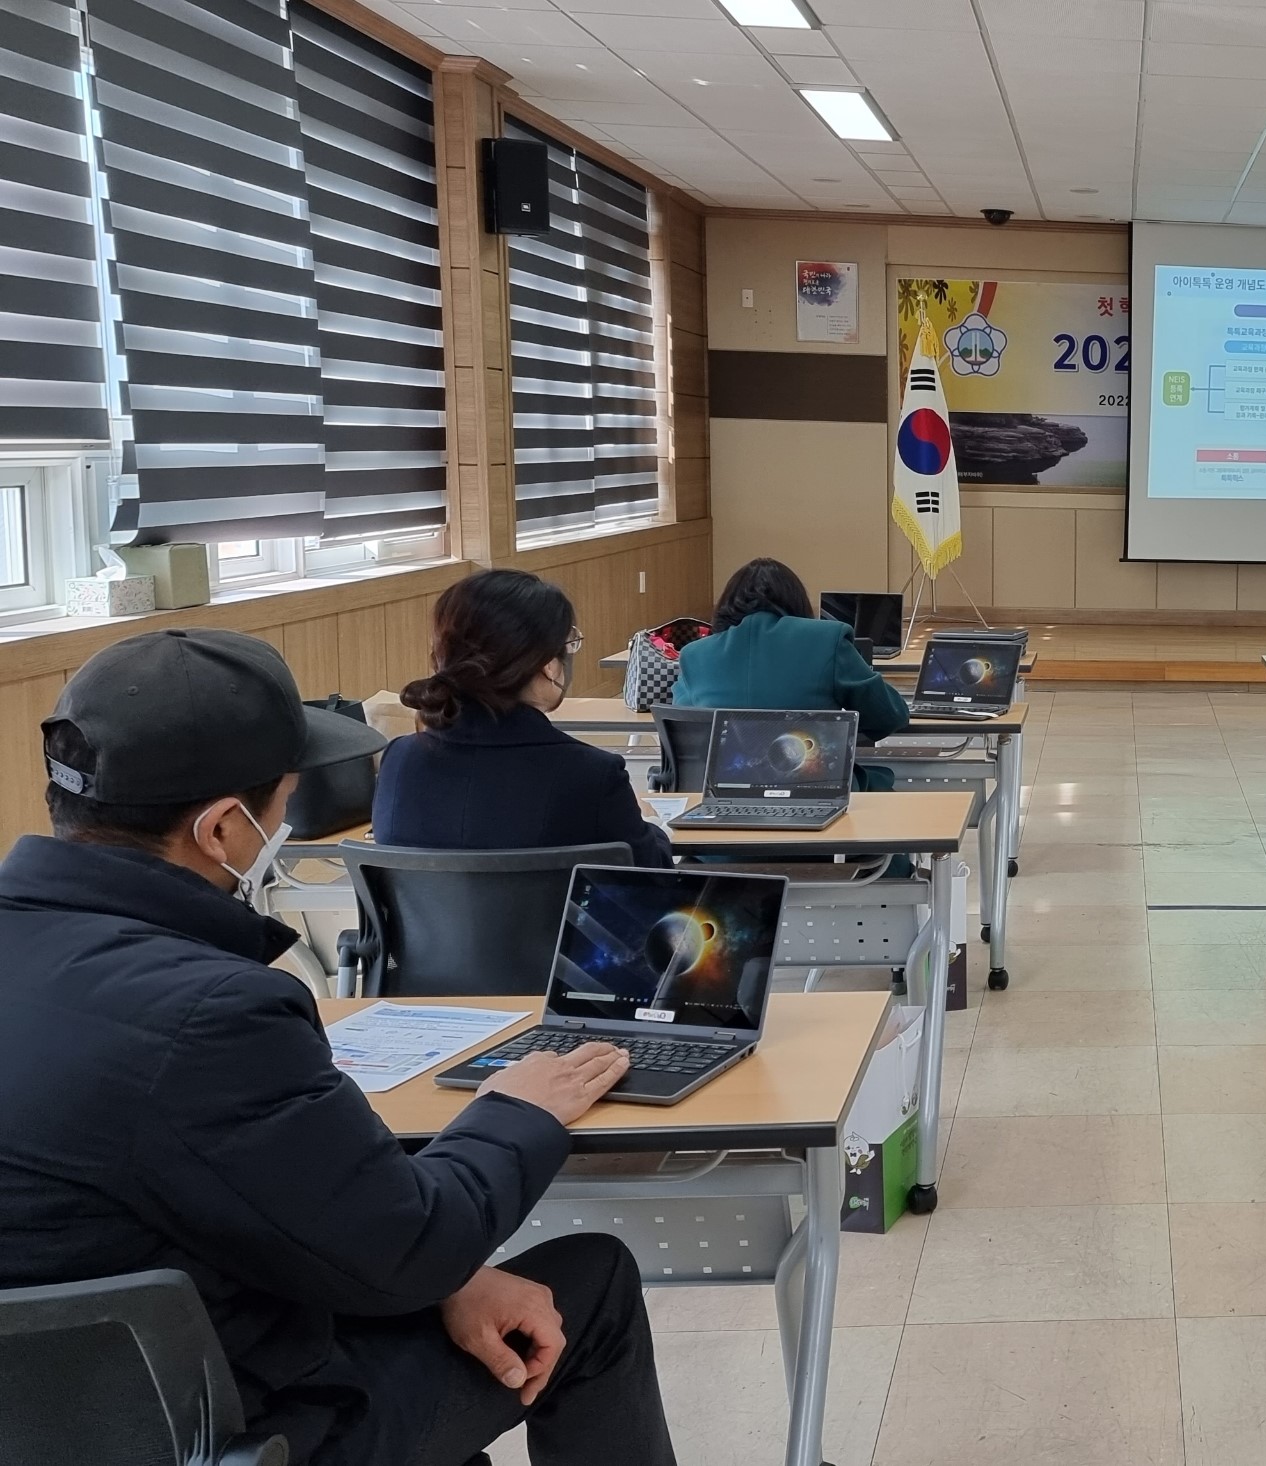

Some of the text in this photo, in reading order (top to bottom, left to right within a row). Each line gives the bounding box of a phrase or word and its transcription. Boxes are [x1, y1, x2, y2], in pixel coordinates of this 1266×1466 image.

[1172, 275, 1266, 291] 아이톡톡 운영 개념도
[802, 286, 832, 296] 대한민국
[1097, 297, 1114, 317] 첫
[1168, 375, 1185, 384] NEIS
[1170, 384, 1183, 393] 등록
[1169, 394, 1183, 402] 연계
[1226, 452, 1239, 461] 소통
